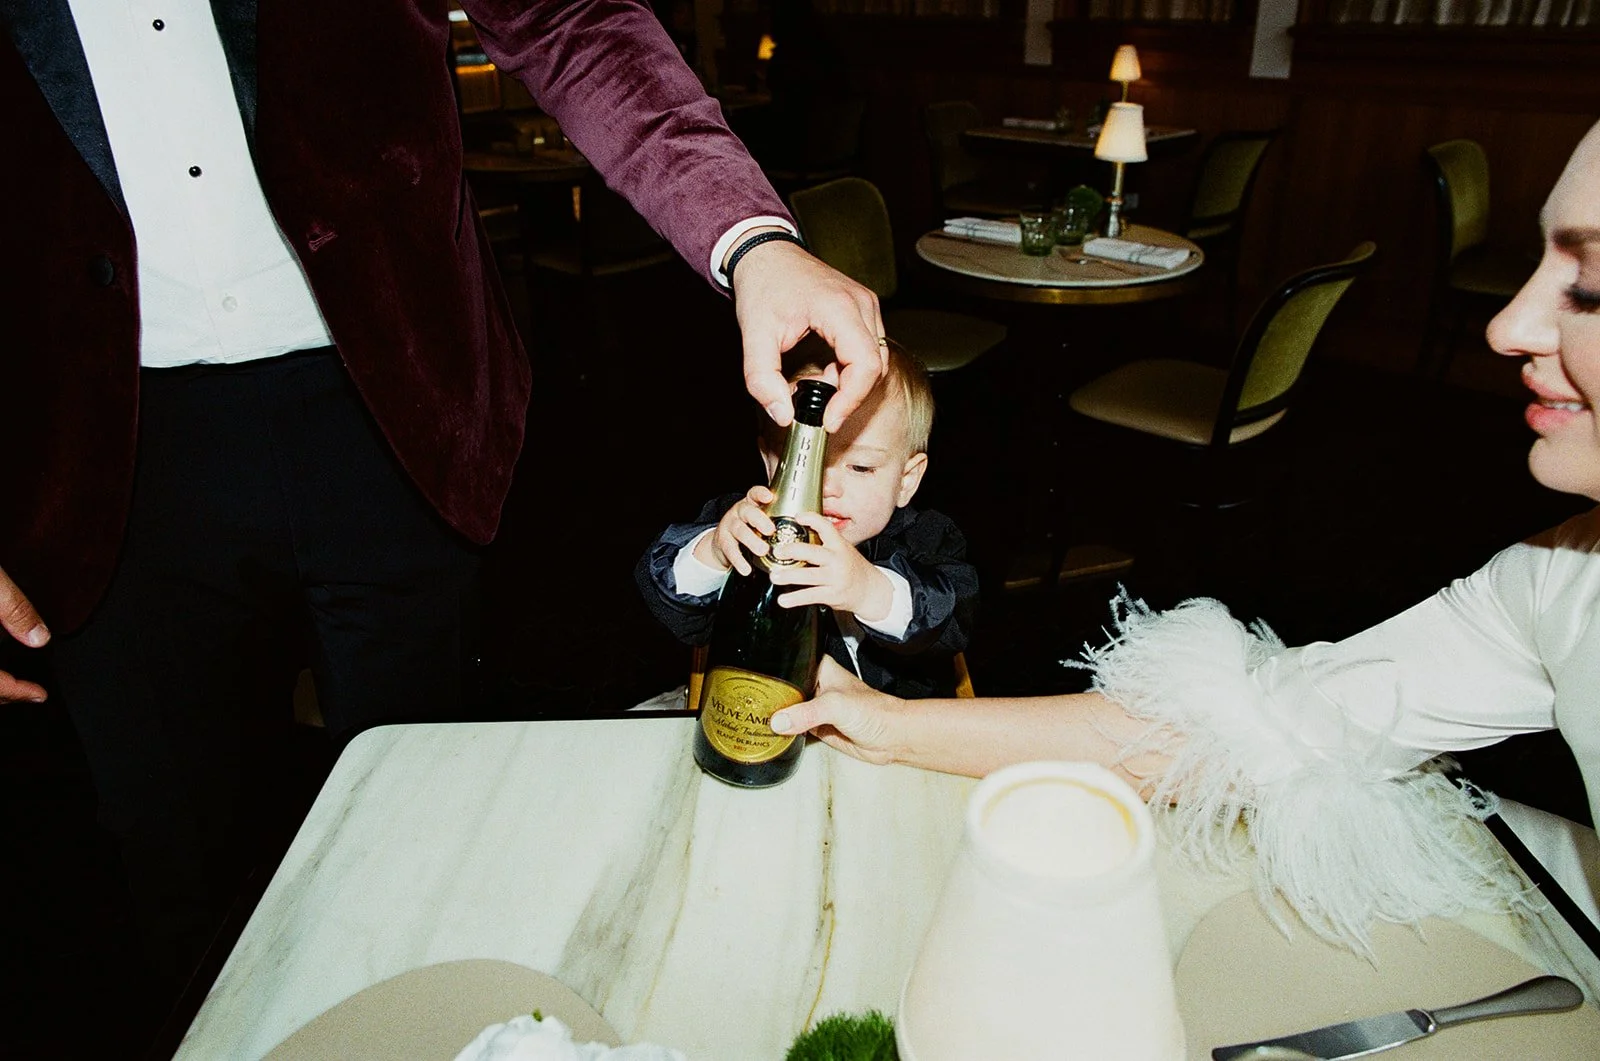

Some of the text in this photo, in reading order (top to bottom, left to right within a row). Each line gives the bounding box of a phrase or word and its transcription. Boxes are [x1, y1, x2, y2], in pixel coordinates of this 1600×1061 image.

[790, 436, 811, 500] BRUT
[711, 696, 743, 721] VEUVE
[745, 739, 770, 748] BLANCS
